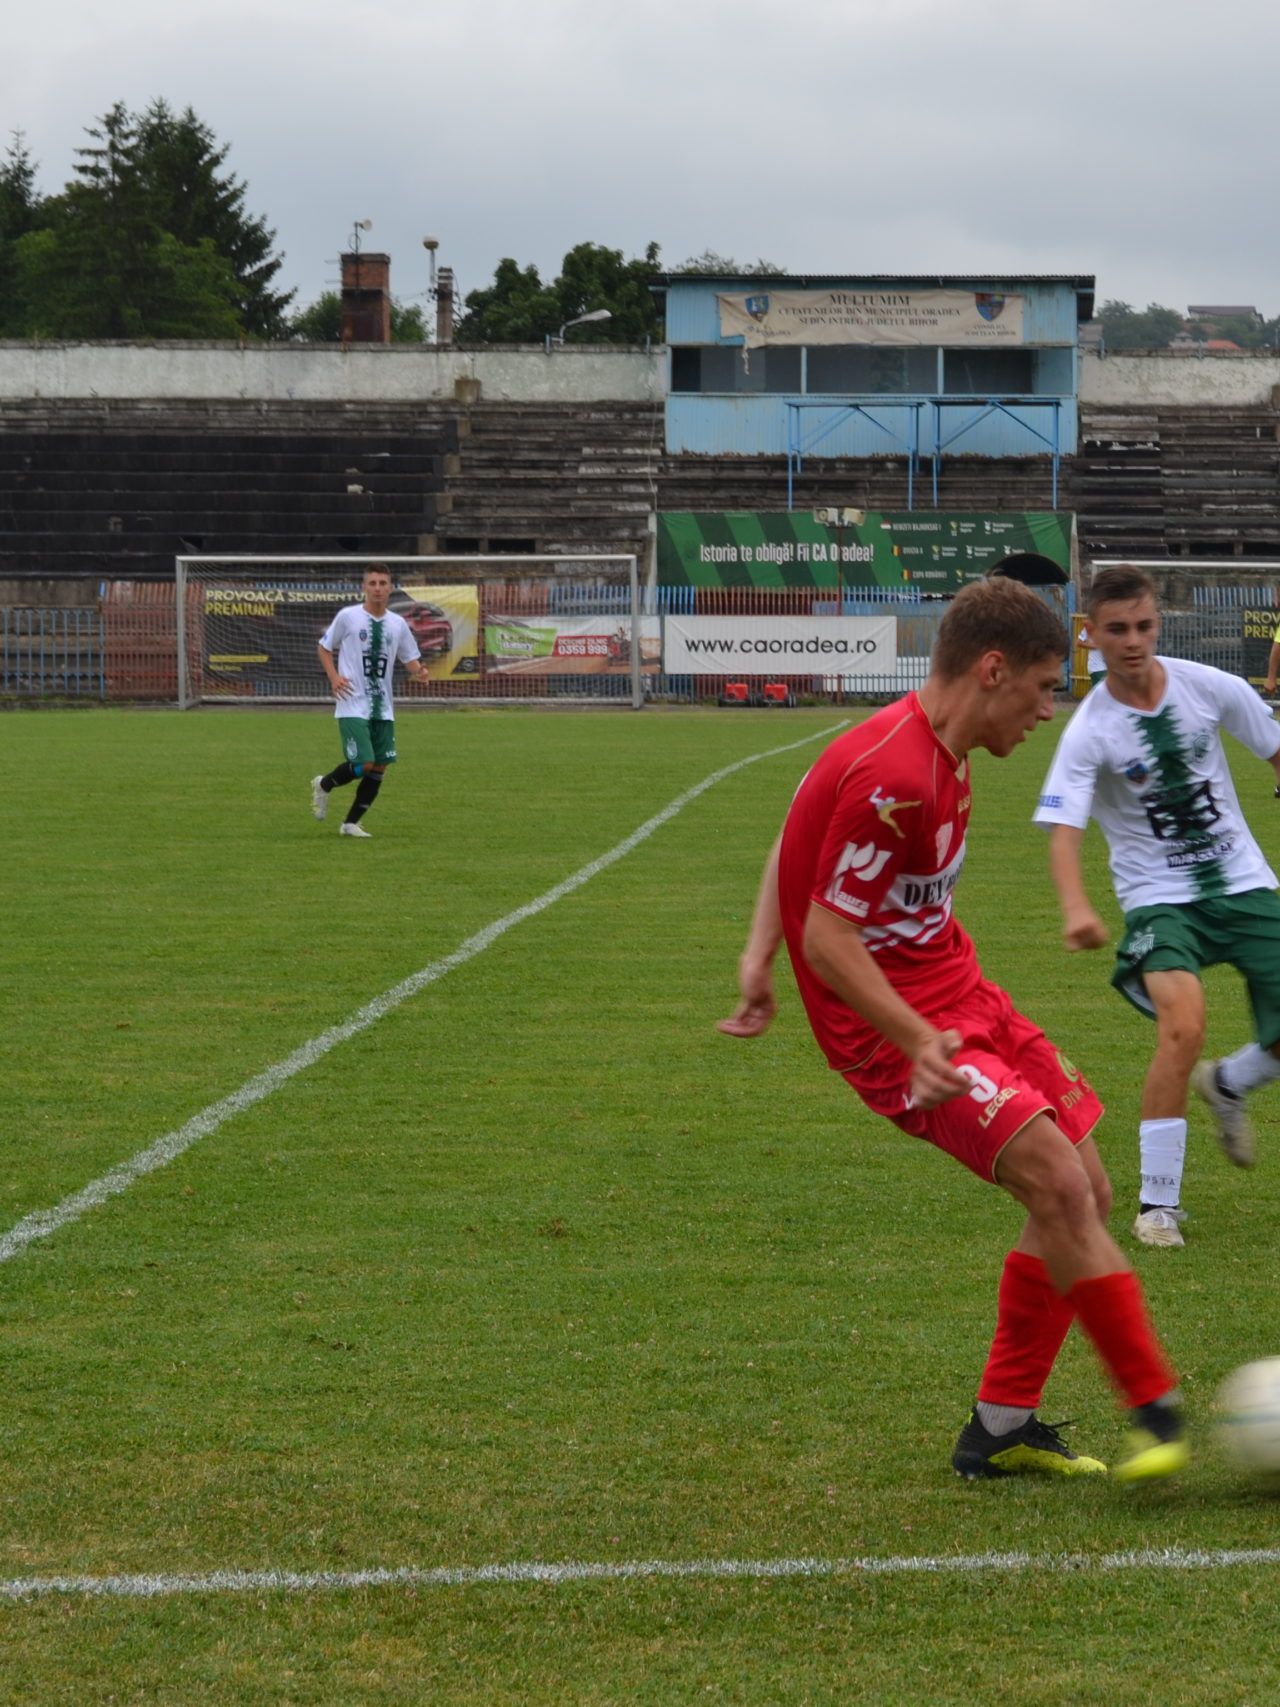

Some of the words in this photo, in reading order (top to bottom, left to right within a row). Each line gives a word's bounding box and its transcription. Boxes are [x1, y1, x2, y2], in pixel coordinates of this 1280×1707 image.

[700, 543, 738, 562] Istoria
[740, 544, 753, 562] te
[755, 542, 794, 565] obligă!
[797, 543, 810, 562] Fii
[812, 543, 828, 562] CA
[830, 542, 874, 563] Oadea!
[205, 589, 285, 603] PROVOACĂ
[287, 591, 367, 603] SEGMENTU
[204, 602, 275, 617] PREMIUM!
[1244, 625, 1277, 638] PREM
[685, 636, 877, 654] www.caoradea.ro
[956, 1063, 998, 1104] 3
